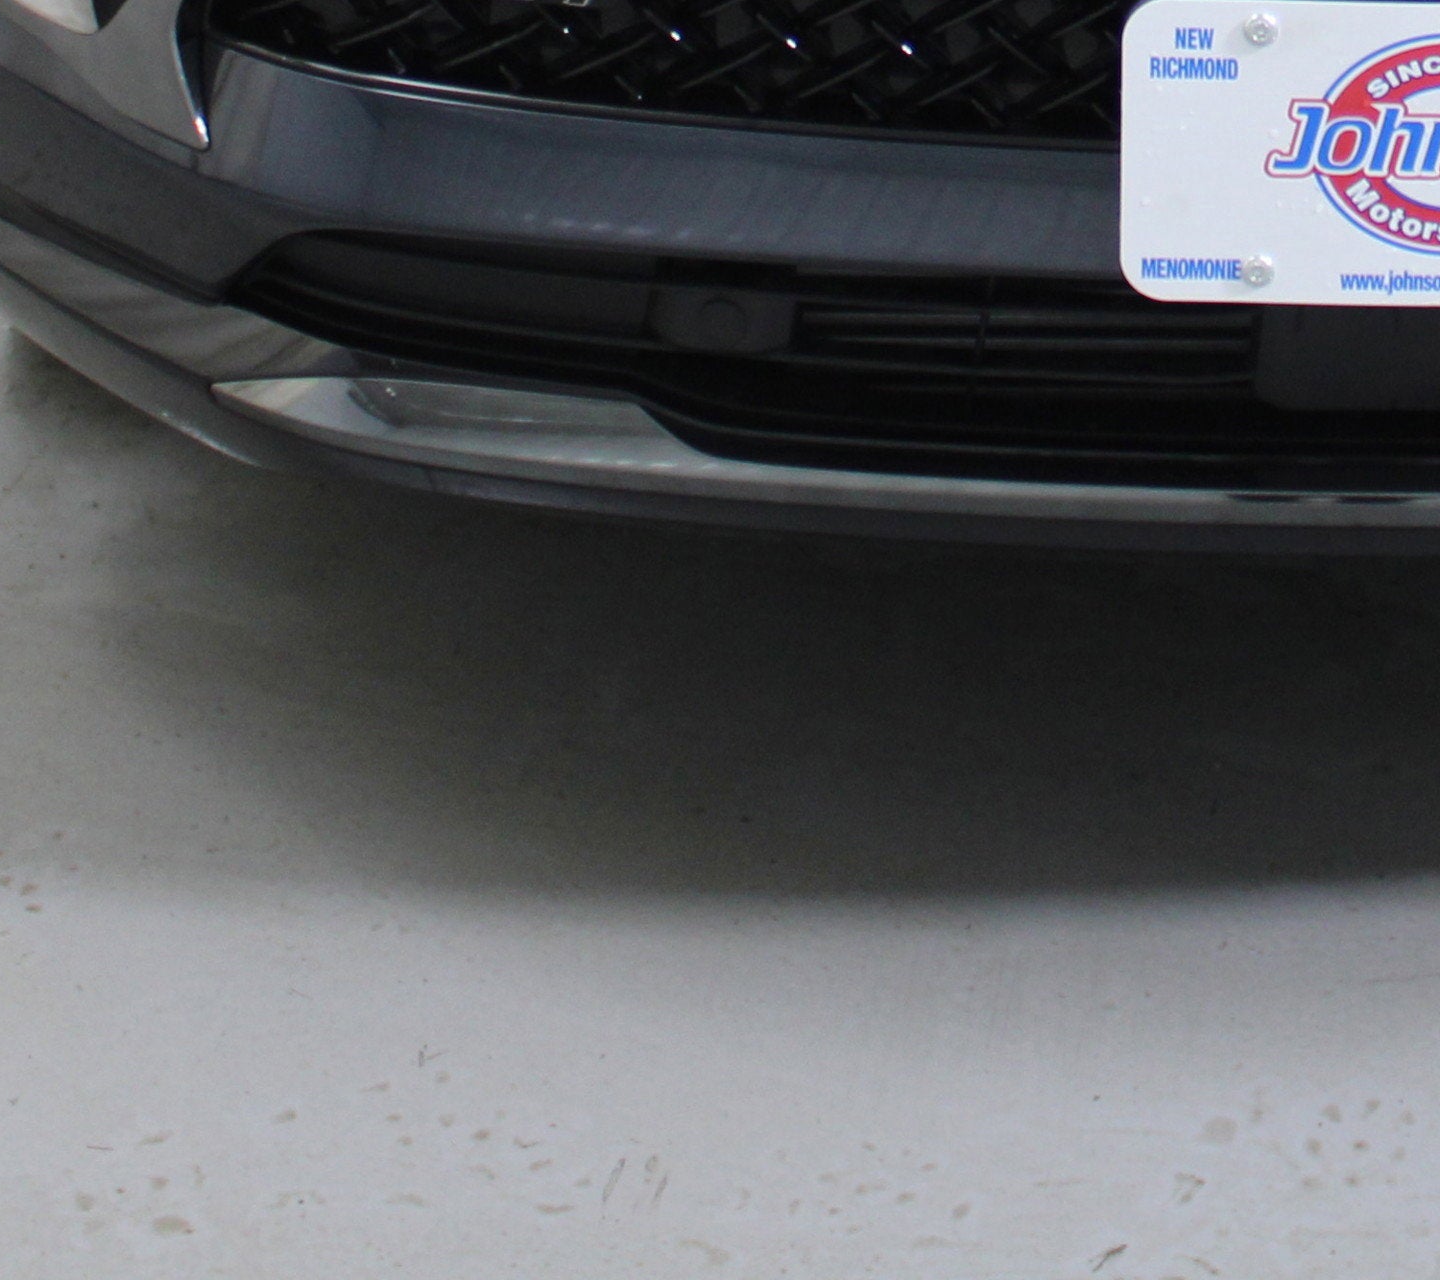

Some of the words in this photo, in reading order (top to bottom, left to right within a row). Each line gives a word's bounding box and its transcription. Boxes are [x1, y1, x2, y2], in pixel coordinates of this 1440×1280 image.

[1174, 27, 1215, 51] NEW
[1149, 56, 1240, 81] RICHMOND
[1140, 257, 1242, 281] MENOMONIE
